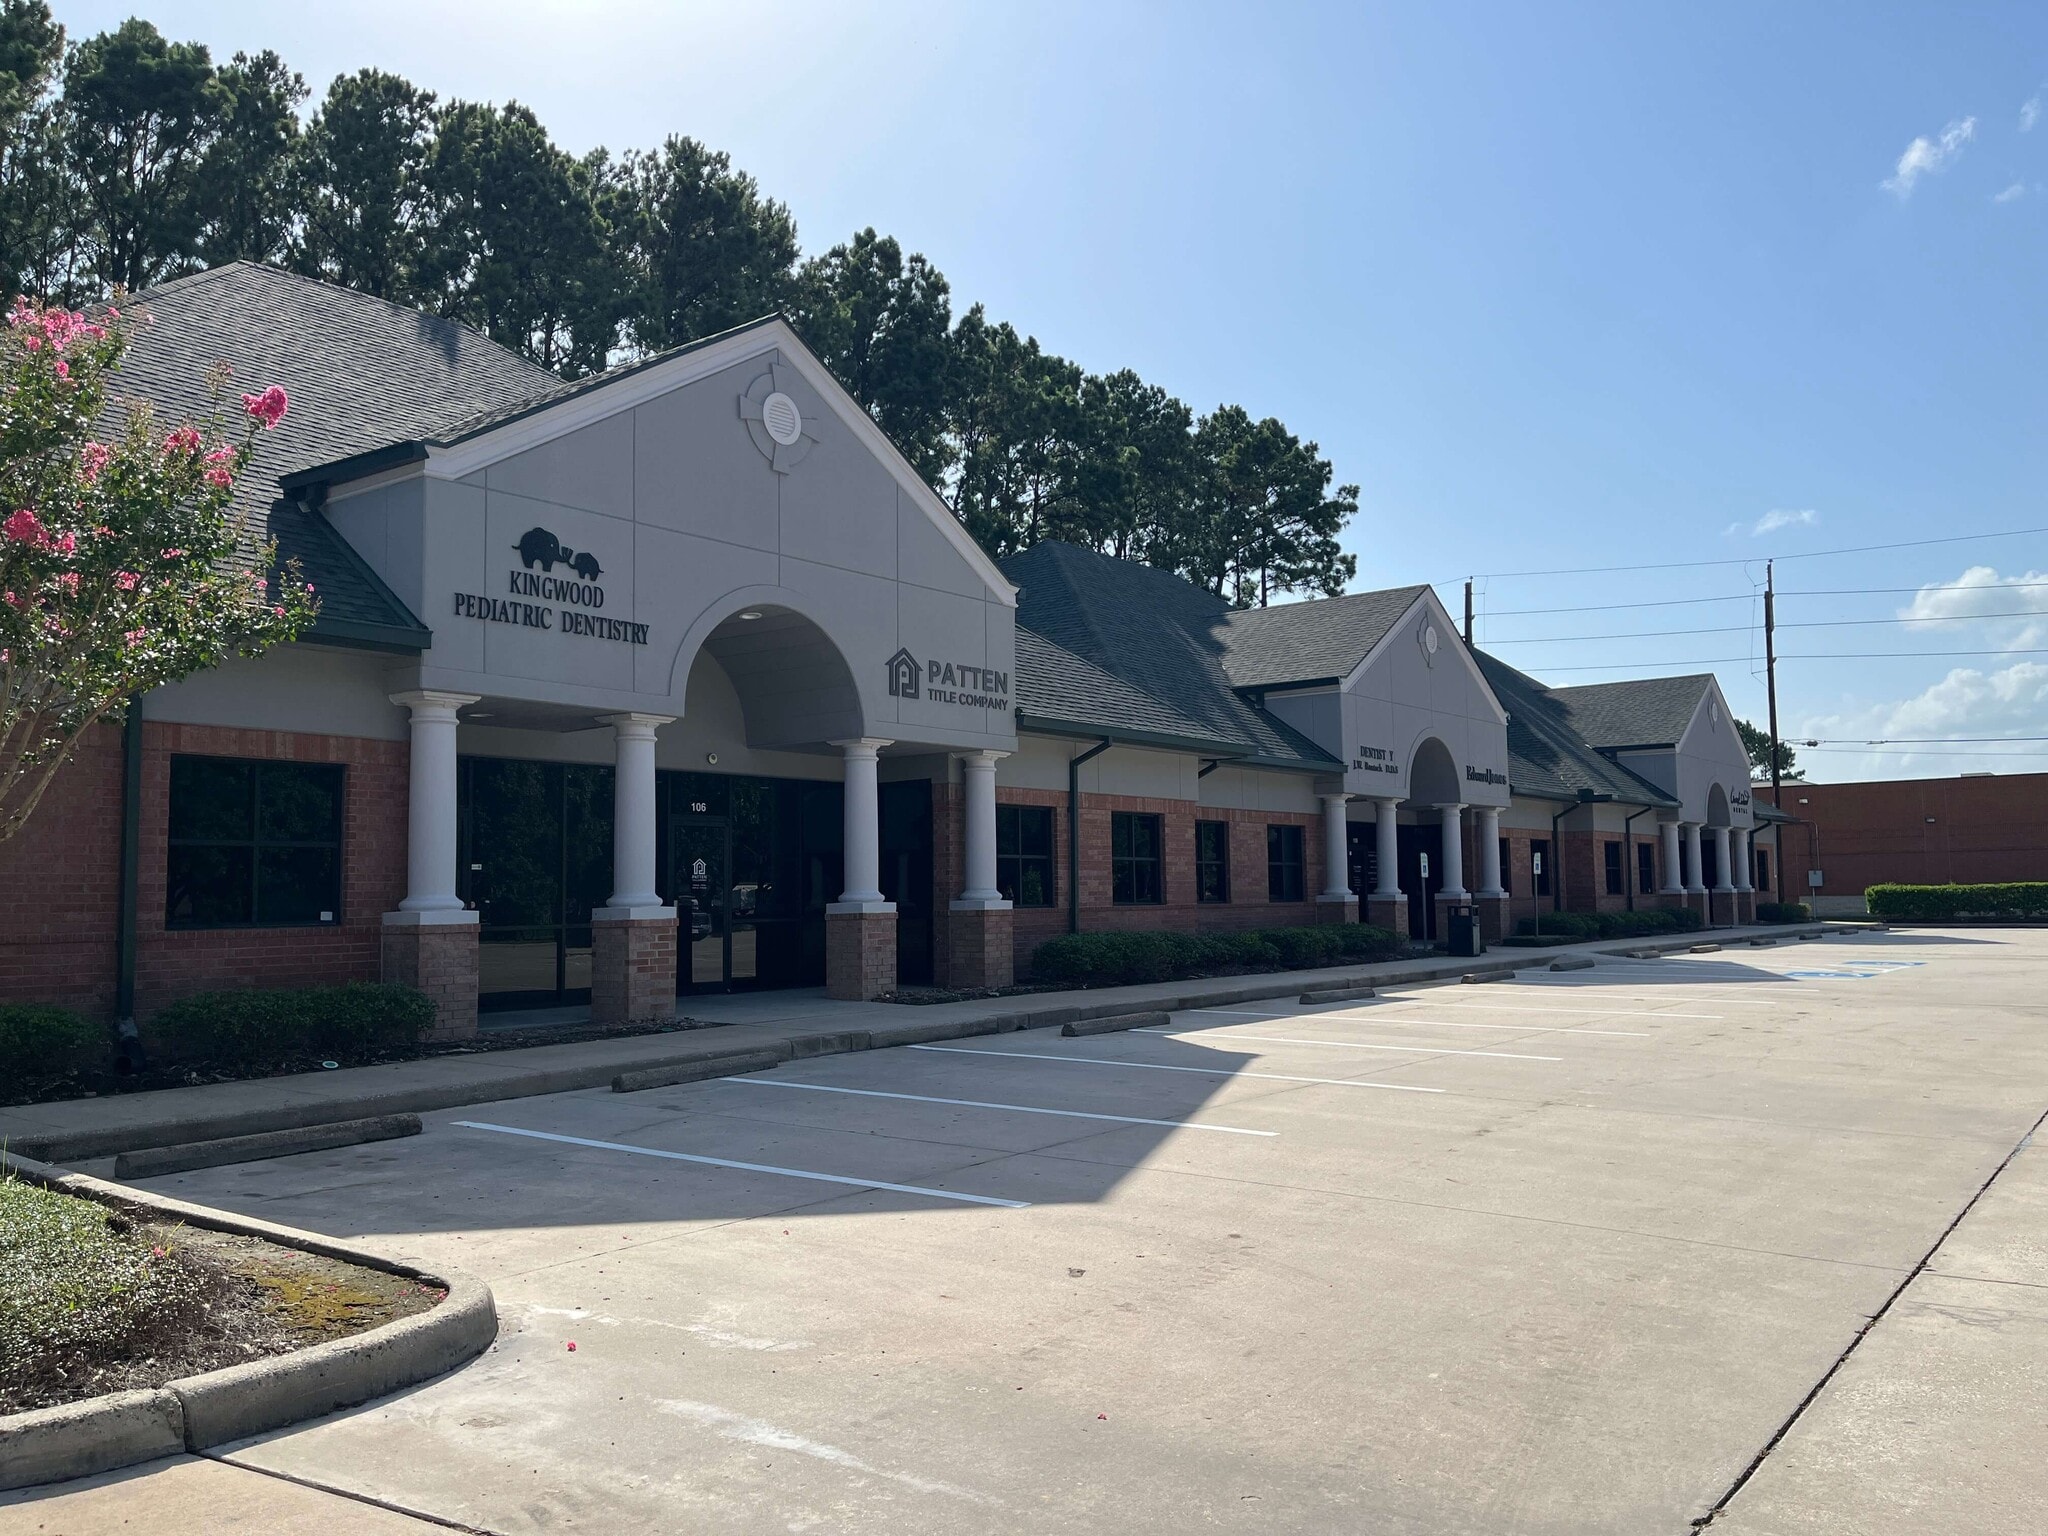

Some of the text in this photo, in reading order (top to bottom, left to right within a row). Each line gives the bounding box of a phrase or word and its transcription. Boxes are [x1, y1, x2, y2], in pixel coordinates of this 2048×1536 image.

[509, 570, 604, 608] KINGWOOD
[454, 592, 650, 645] PEDIATRIC DENTISTRY
[928, 660, 1008, 694] PATTEN
[928, 688, 1008, 711] TITLE COMPANY
[691, 802, 706, 812] 106
